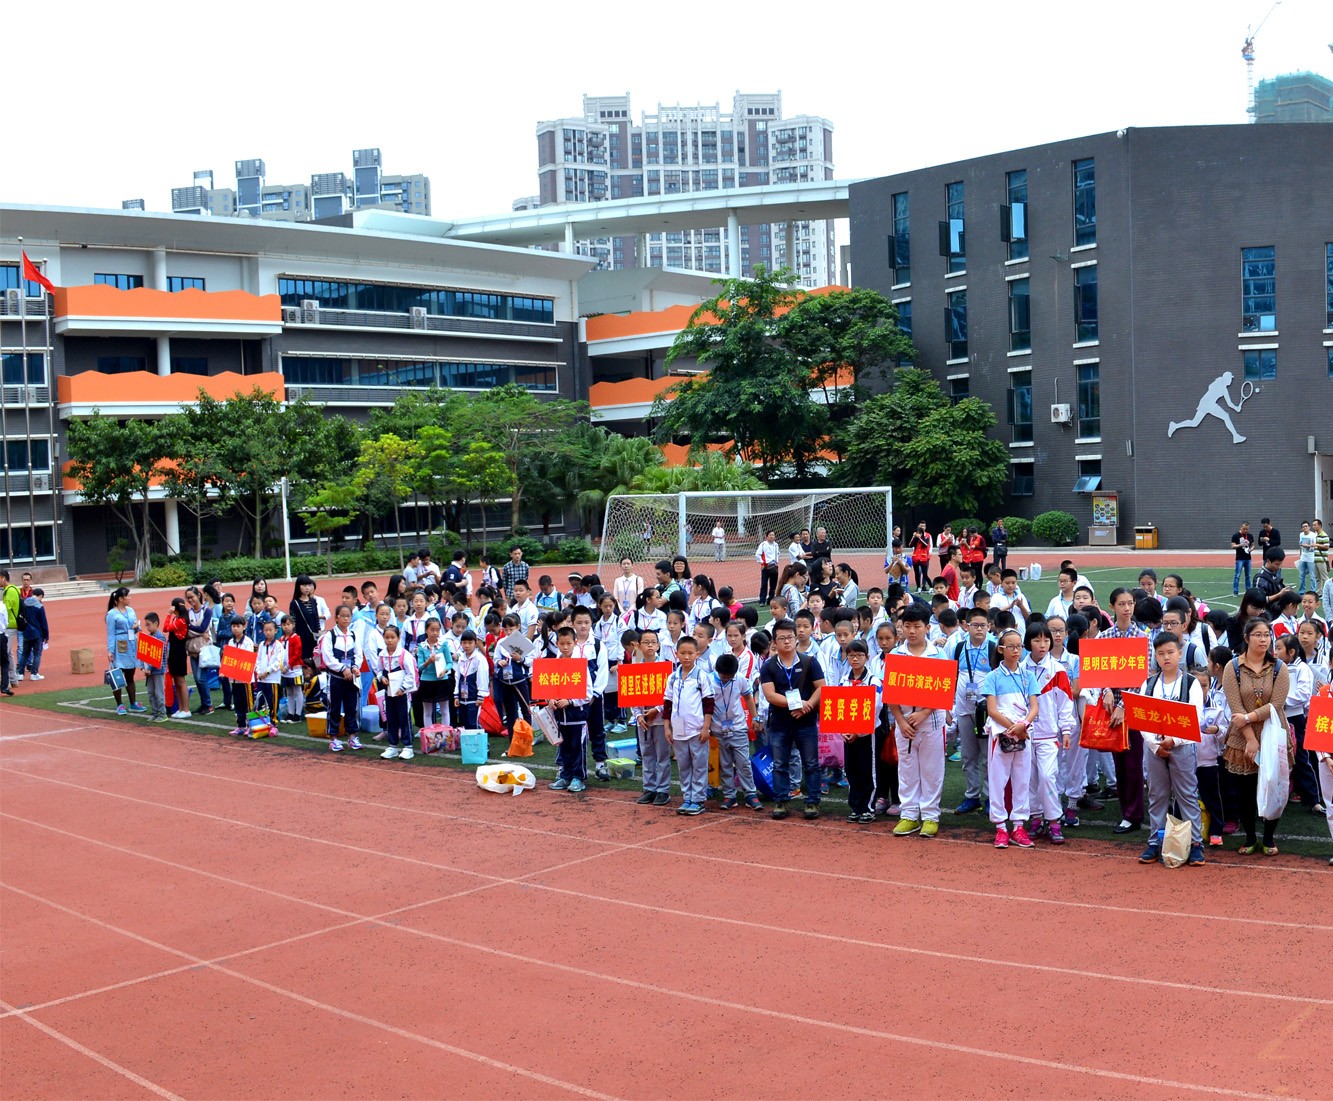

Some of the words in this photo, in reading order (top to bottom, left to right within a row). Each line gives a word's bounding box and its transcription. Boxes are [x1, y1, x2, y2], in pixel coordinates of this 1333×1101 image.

[1082, 655, 1146, 672] 思明区青少年宫
[538, 671, 582, 686] 松柏小学
[887, 672, 951, 693] 厦门市演武小学
[824, 698, 872, 721] 英贤学校
[1132, 707, 1192, 728] 莲龙小学
